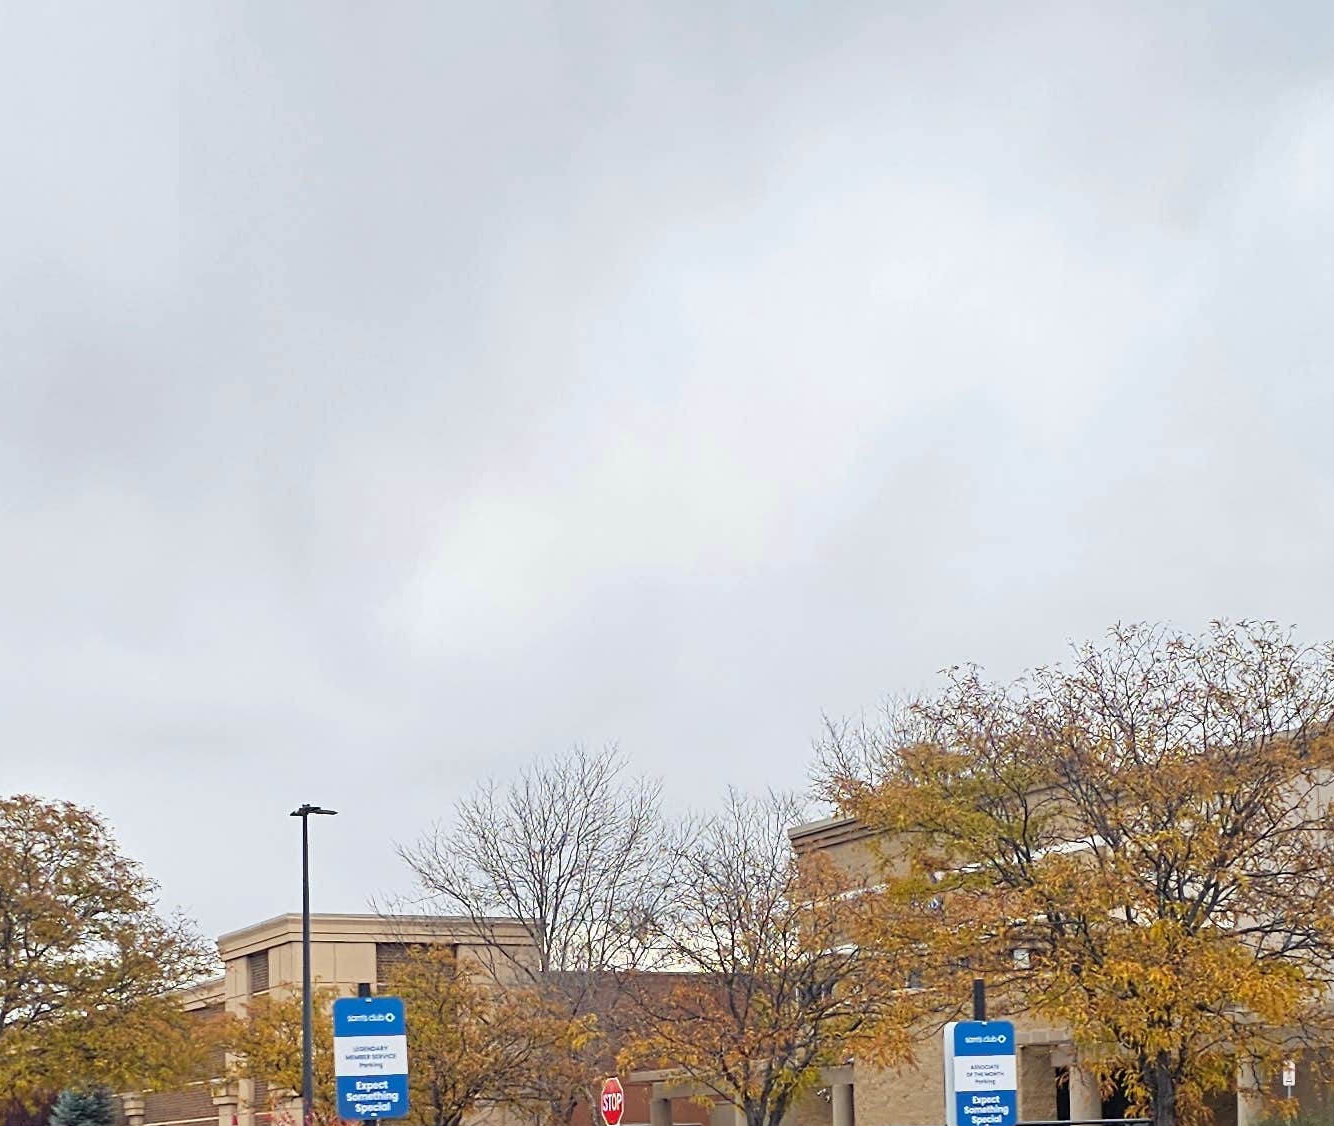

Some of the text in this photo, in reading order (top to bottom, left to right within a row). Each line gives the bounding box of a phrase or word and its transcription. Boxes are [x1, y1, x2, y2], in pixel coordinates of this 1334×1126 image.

[369, 1013, 385, 1022] club
[982, 1035, 997, 1043] club
[355, 1081, 388, 1093] Expect
[346, 1091, 399, 1102] Something
[603, 1092, 622, 1112] STOP
[972, 1096, 1000, 1106] Expect
[355, 1102, 391, 1115] Special
[963, 1104, 1009, 1116] Something
[971, 1115, 1003, 1126] Special
